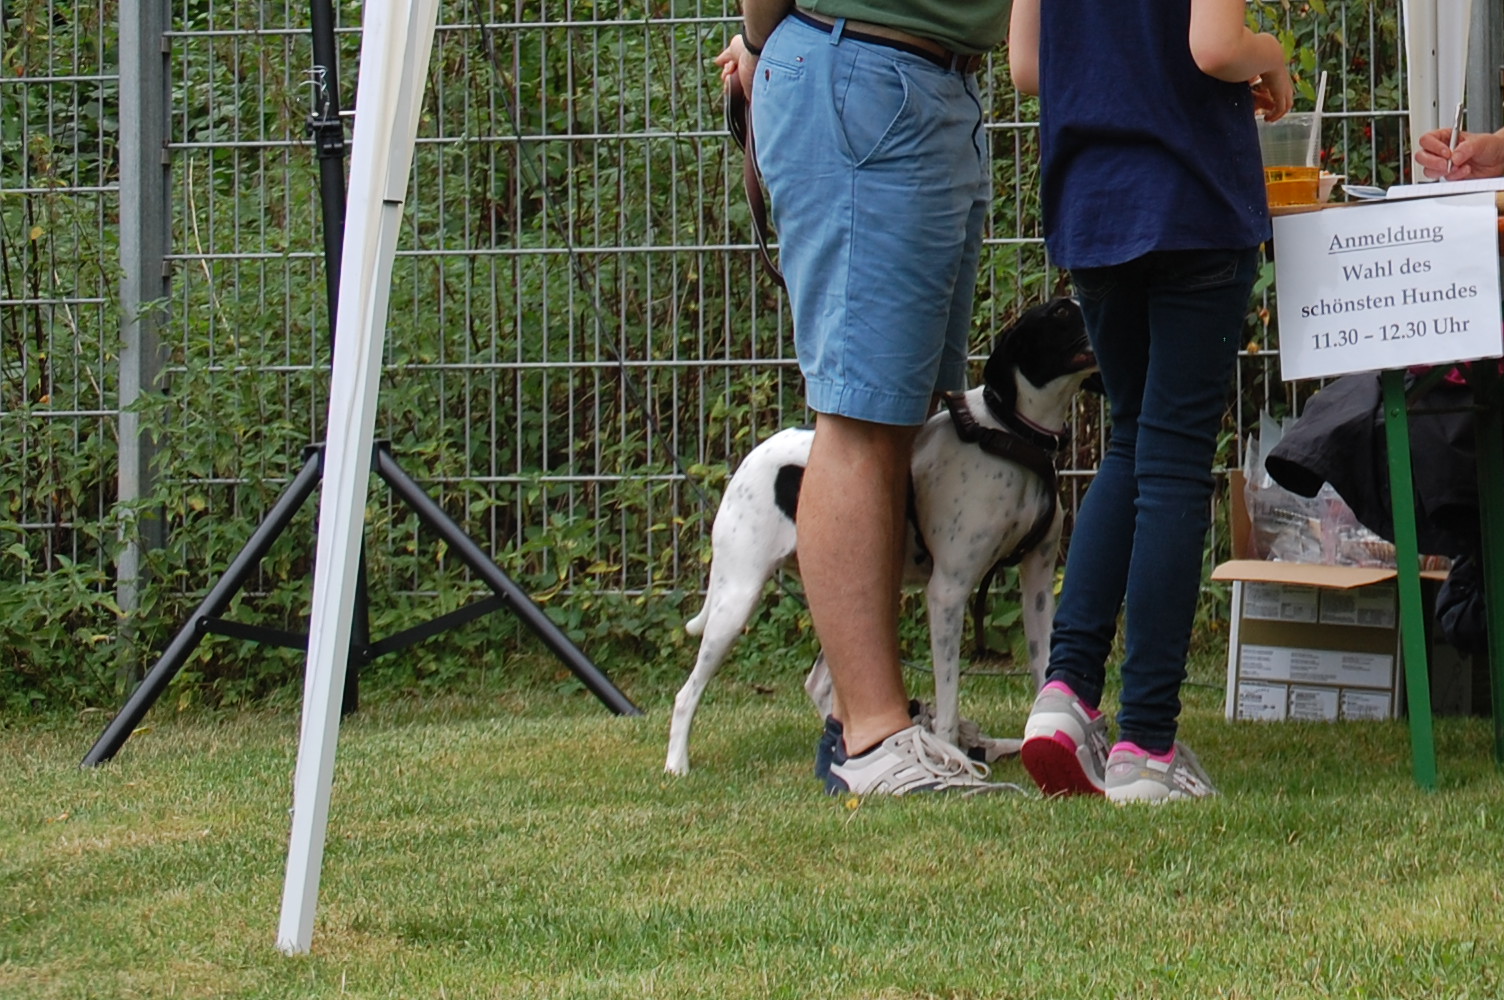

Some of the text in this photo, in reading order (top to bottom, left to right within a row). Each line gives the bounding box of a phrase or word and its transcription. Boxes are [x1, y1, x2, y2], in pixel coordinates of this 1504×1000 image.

[1329, 225, 1444, 251] Anmeldung
[1342, 258, 1432, 281] Wahl des
[1301, 282, 1477, 318] schönsten Hundes
[1312, 329, 1358, 350] 11.30
[1380, 321, 1427, 341] 12.30
[1434, 317, 1470, 335] Uhr
